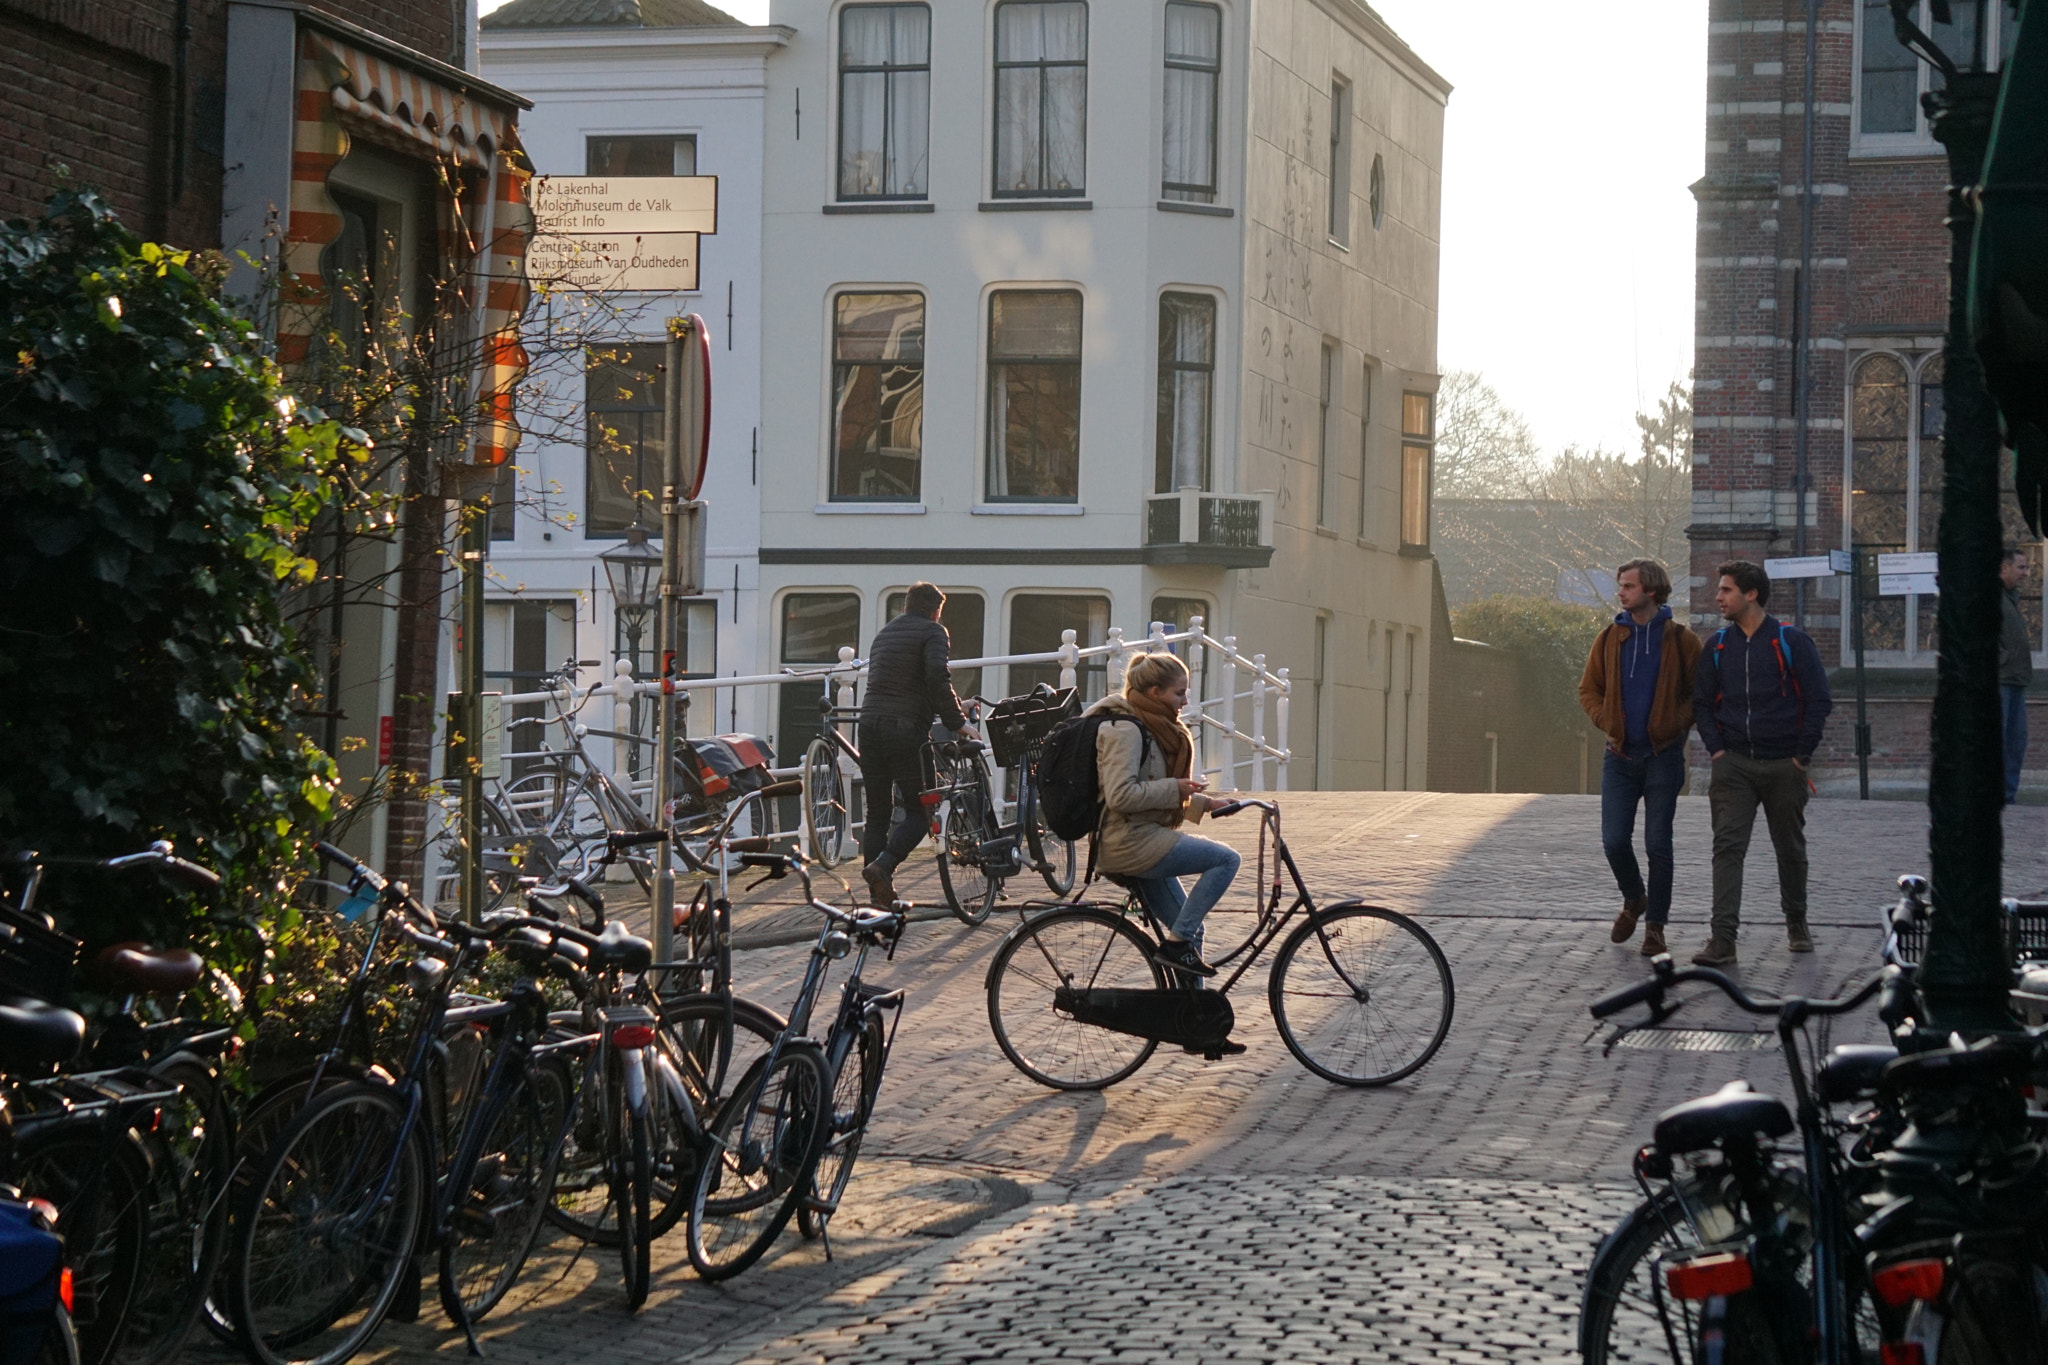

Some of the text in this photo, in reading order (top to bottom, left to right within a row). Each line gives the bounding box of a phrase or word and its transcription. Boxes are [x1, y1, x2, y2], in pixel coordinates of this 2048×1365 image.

[537, 182, 608, 195] De Lakenhal
[537, 198, 672, 212] Molenmuseum de Valk
[537, 214, 605, 227] Tourist Info
[532, 240, 619, 253] Centraal Station
[531, 256, 689, 272] Rijksmuseum van Oudheden
[532, 273, 602, 285] Vlkenkunde
